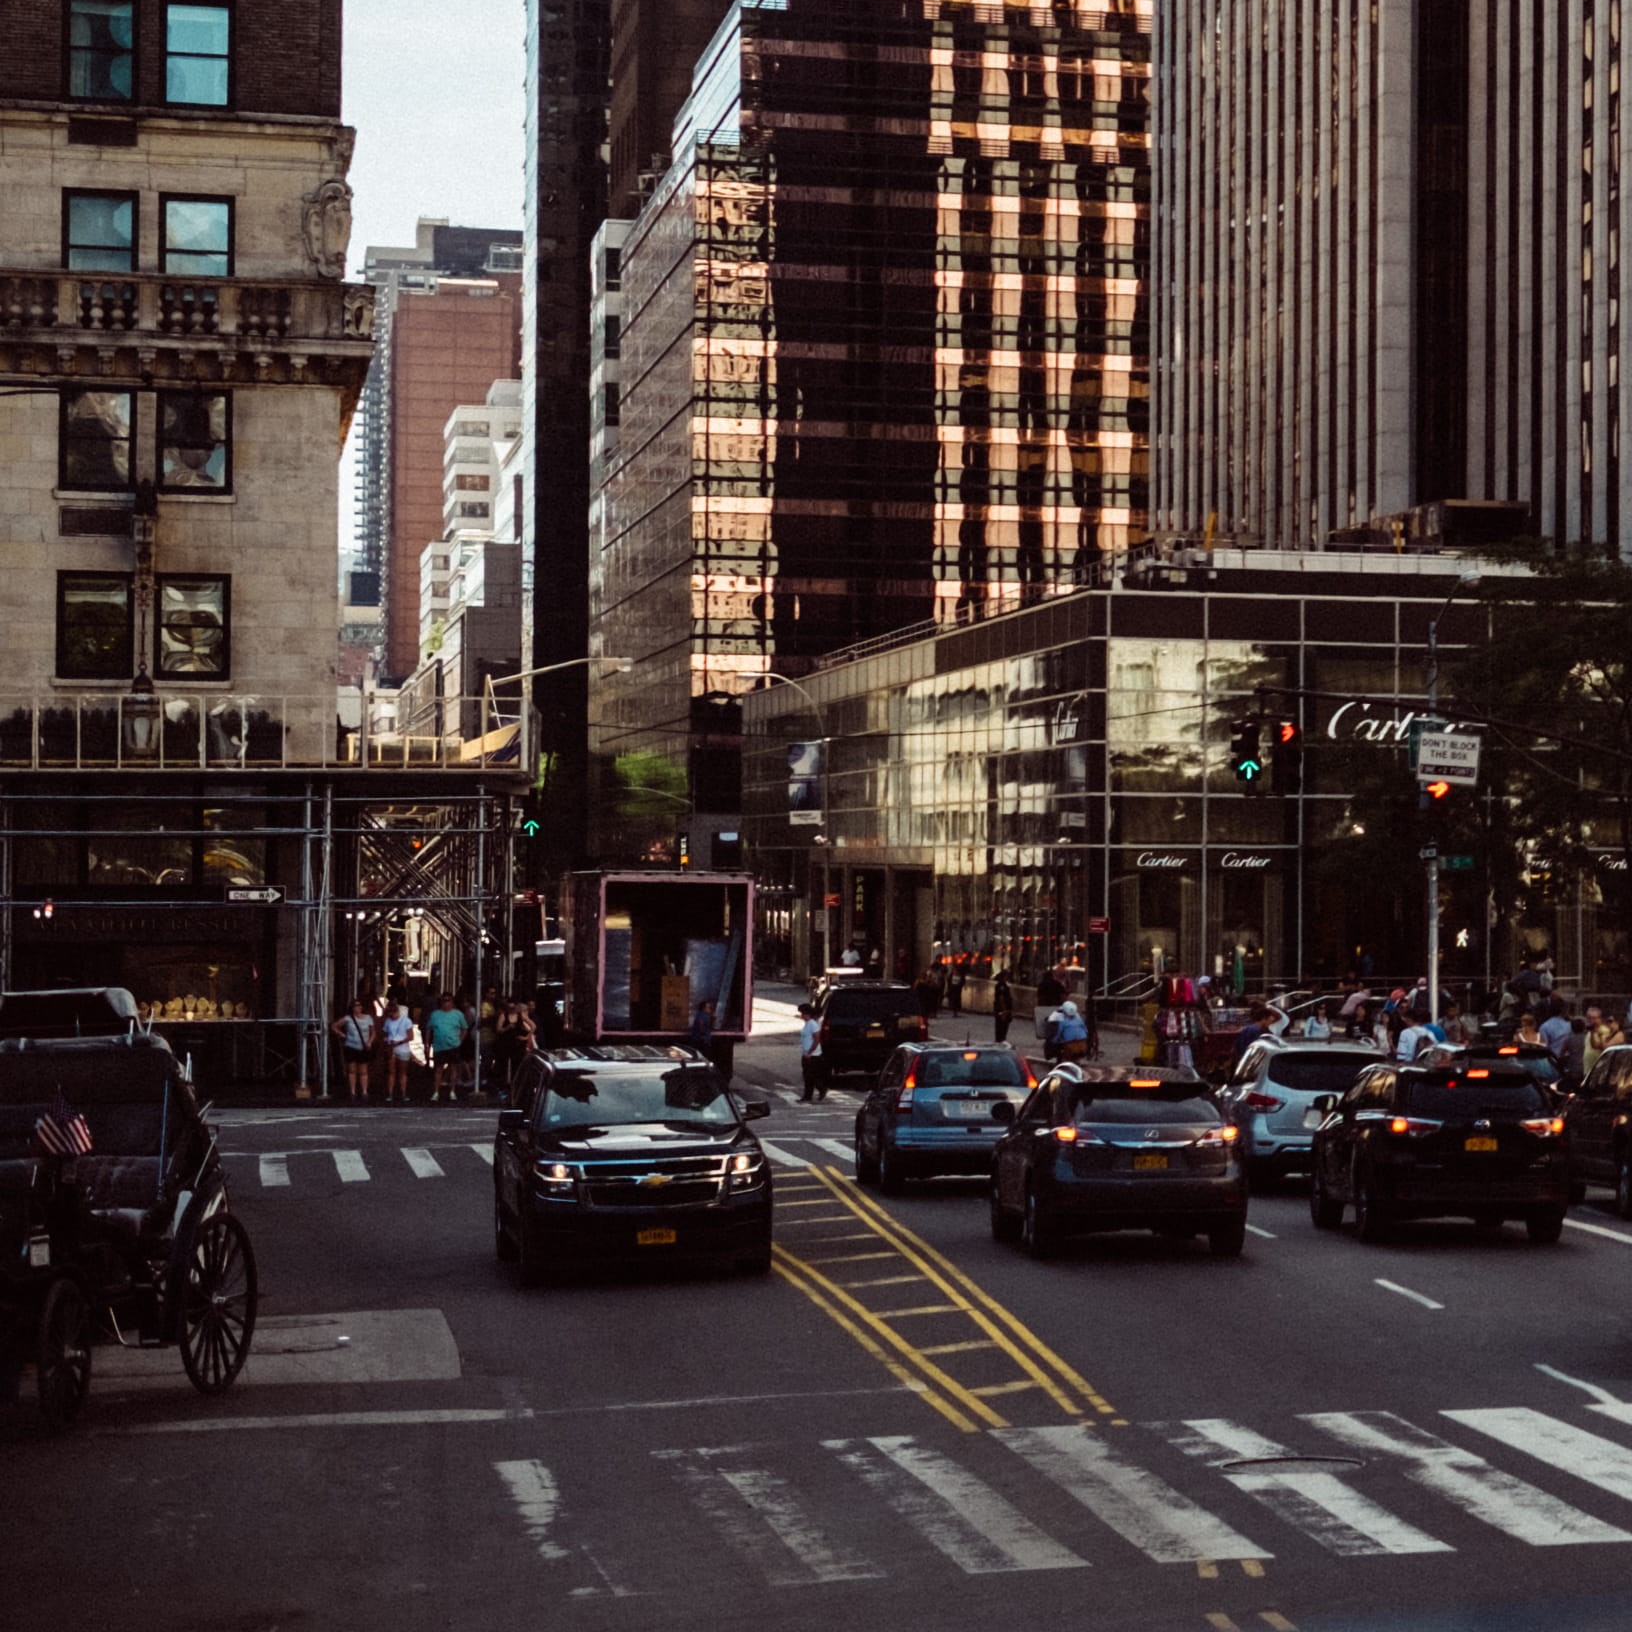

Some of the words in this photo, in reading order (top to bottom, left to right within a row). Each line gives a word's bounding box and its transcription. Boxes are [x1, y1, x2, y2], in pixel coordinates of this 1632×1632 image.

[1422, 739, 1446, 748] DON'T
[1450, 741, 1477, 752] BLOCK
[1431, 749, 1448, 759] THE
[1137, 852, 1188, 867] Cartier
[1221, 852, 1271, 867] Cartier
[855, 875, 864, 912] PARK
